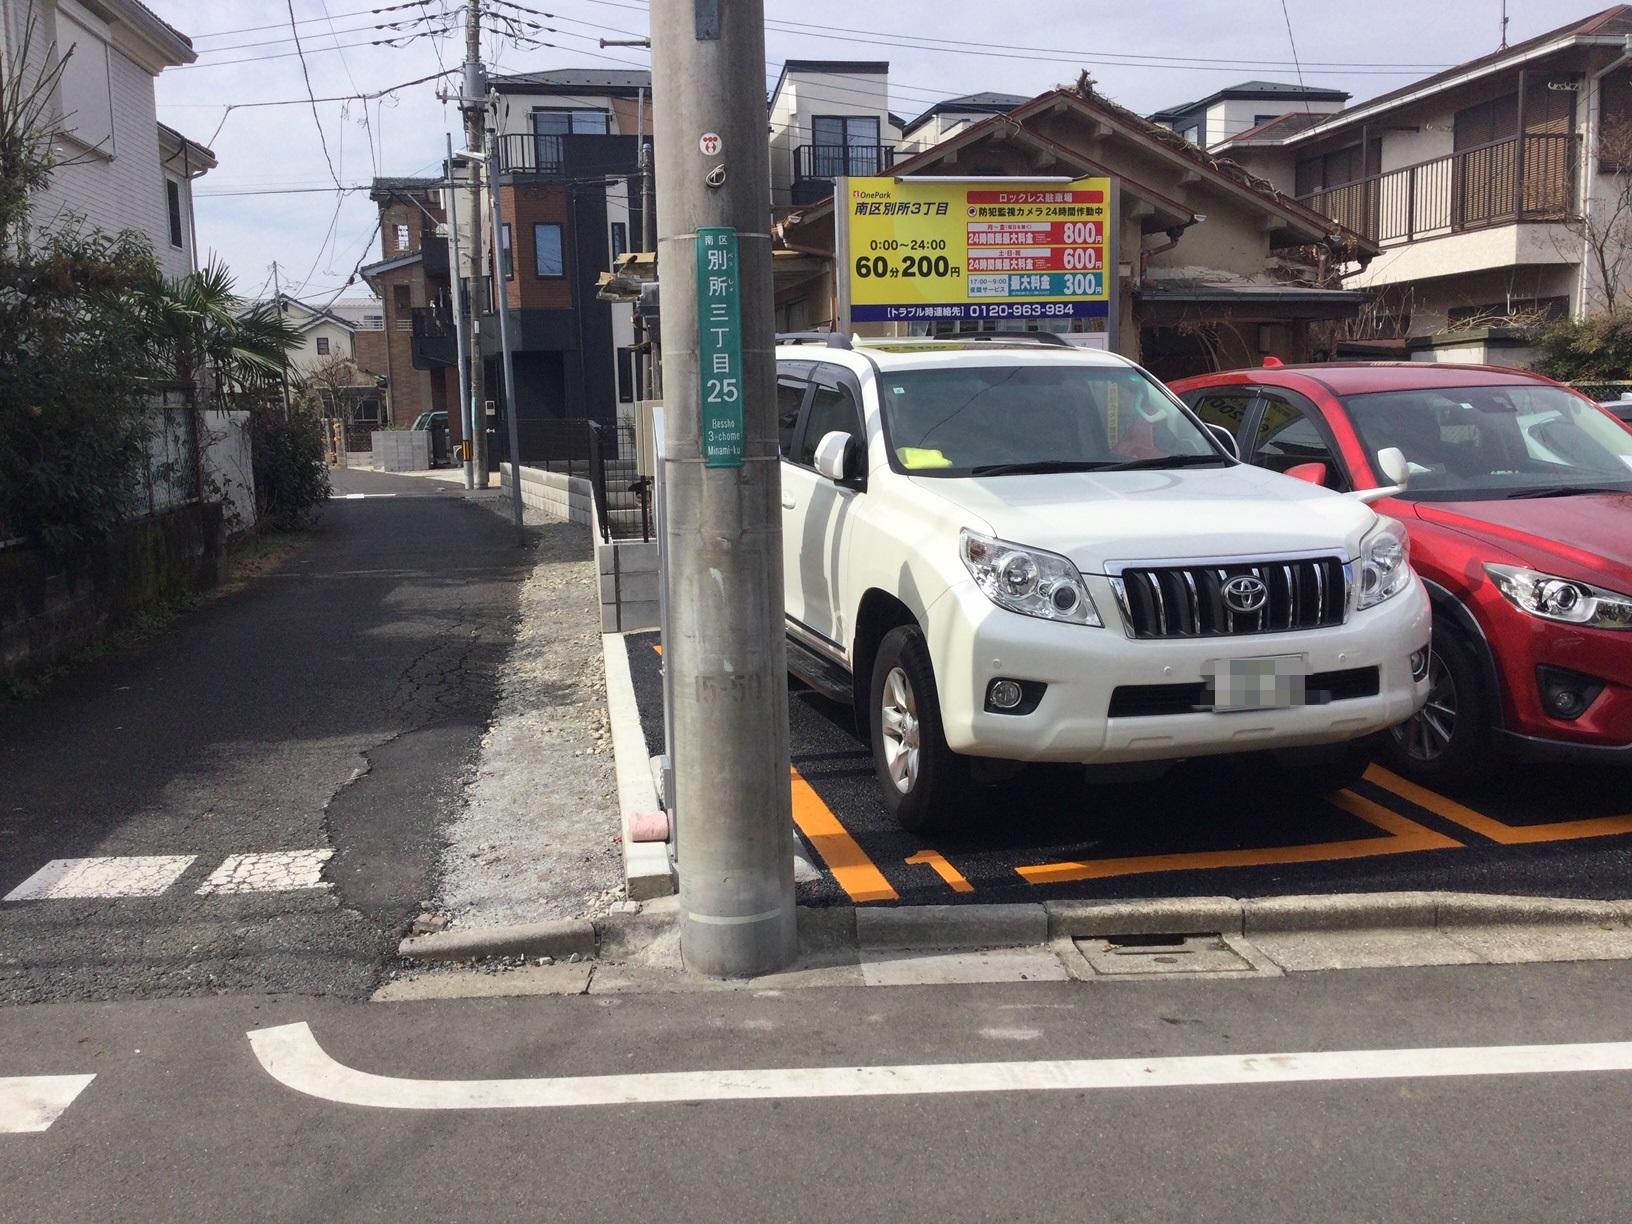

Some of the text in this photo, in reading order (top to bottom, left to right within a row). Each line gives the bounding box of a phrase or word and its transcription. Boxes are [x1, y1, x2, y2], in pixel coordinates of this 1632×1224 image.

[860, 191, 891, 199] OnePark
[999, 192, 1073, 203] ロックレス駐車場
[855, 201, 949, 216] 南区別所3丁目
[704, 235, 729, 246] 南区
[1010, 275, 1051, 290] 最大料金
[707, 249, 730, 374] 別所三丁目
[969, 304, 1075, 317] 0120-963-984
[706, 378, 739, 403] 25
[711, 418, 736, 429] Bessho
[708, 430, 740, 441] 3-chome
[708, 444, 741, 456] Minami-ku
[904, 849, 974, 892] 1
